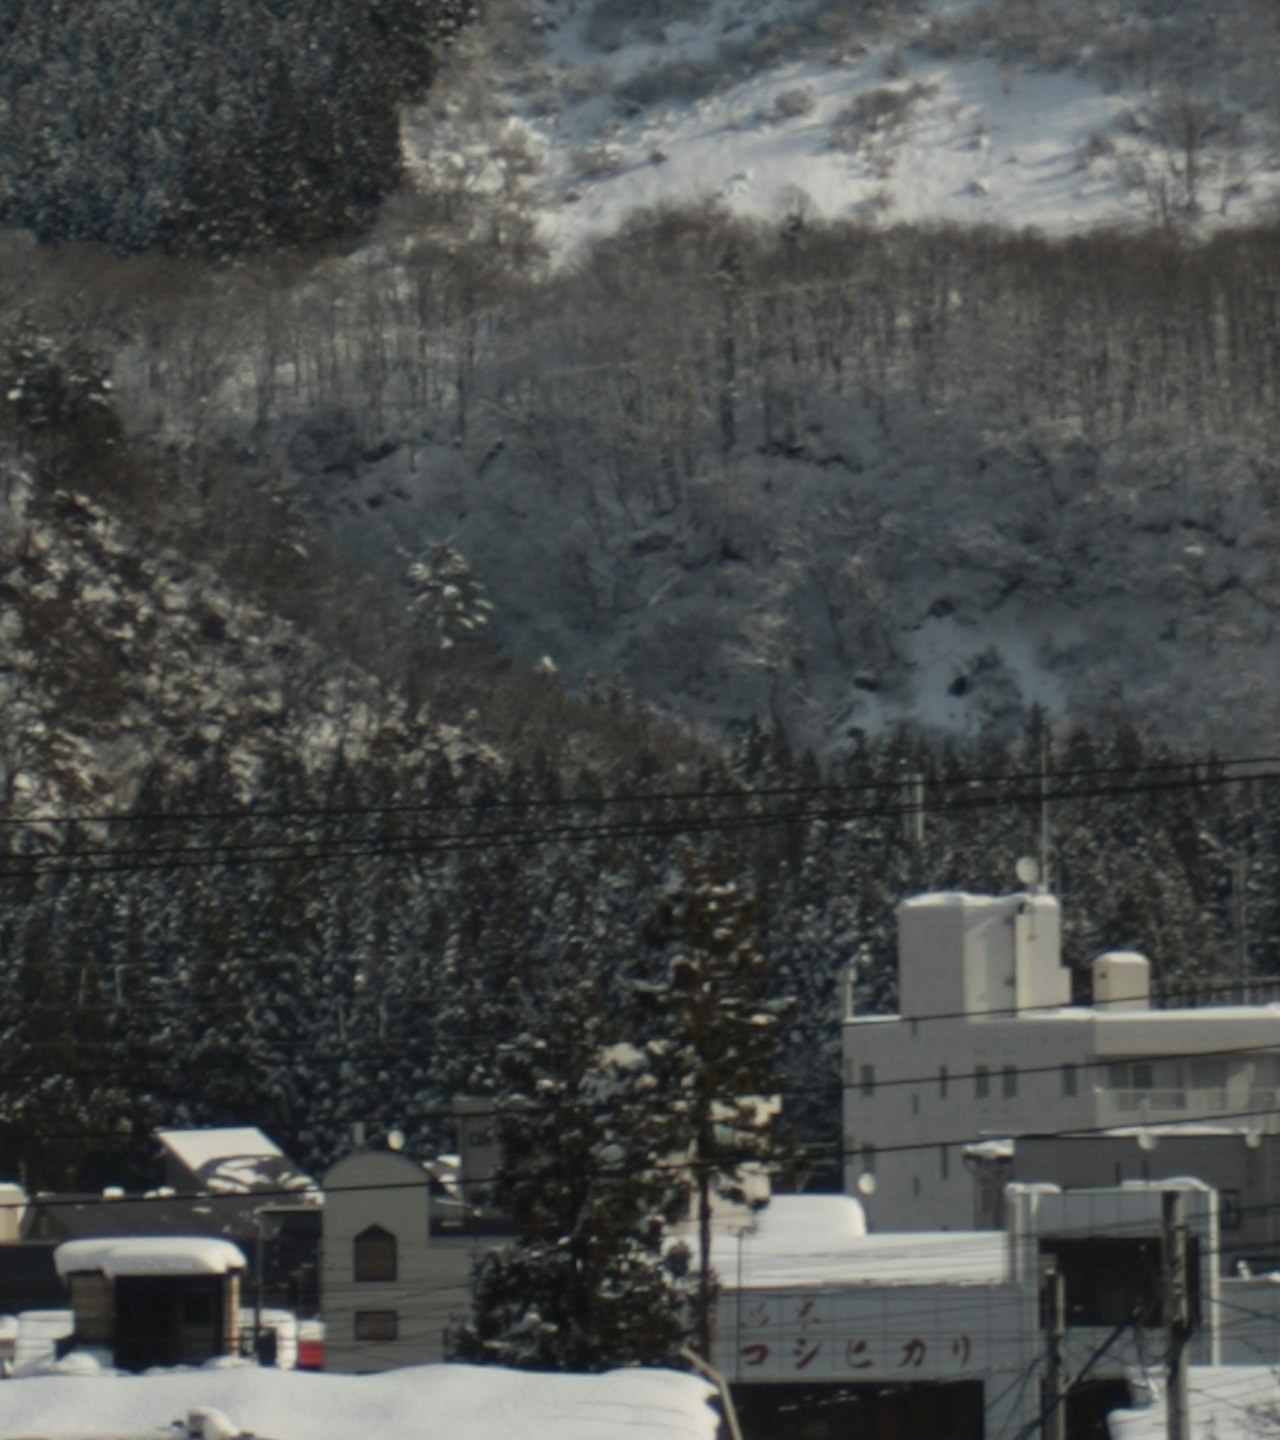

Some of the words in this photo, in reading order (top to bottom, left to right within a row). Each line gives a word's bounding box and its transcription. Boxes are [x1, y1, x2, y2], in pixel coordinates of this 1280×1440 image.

[741, 1336, 972, 1368] コシヒカリ
